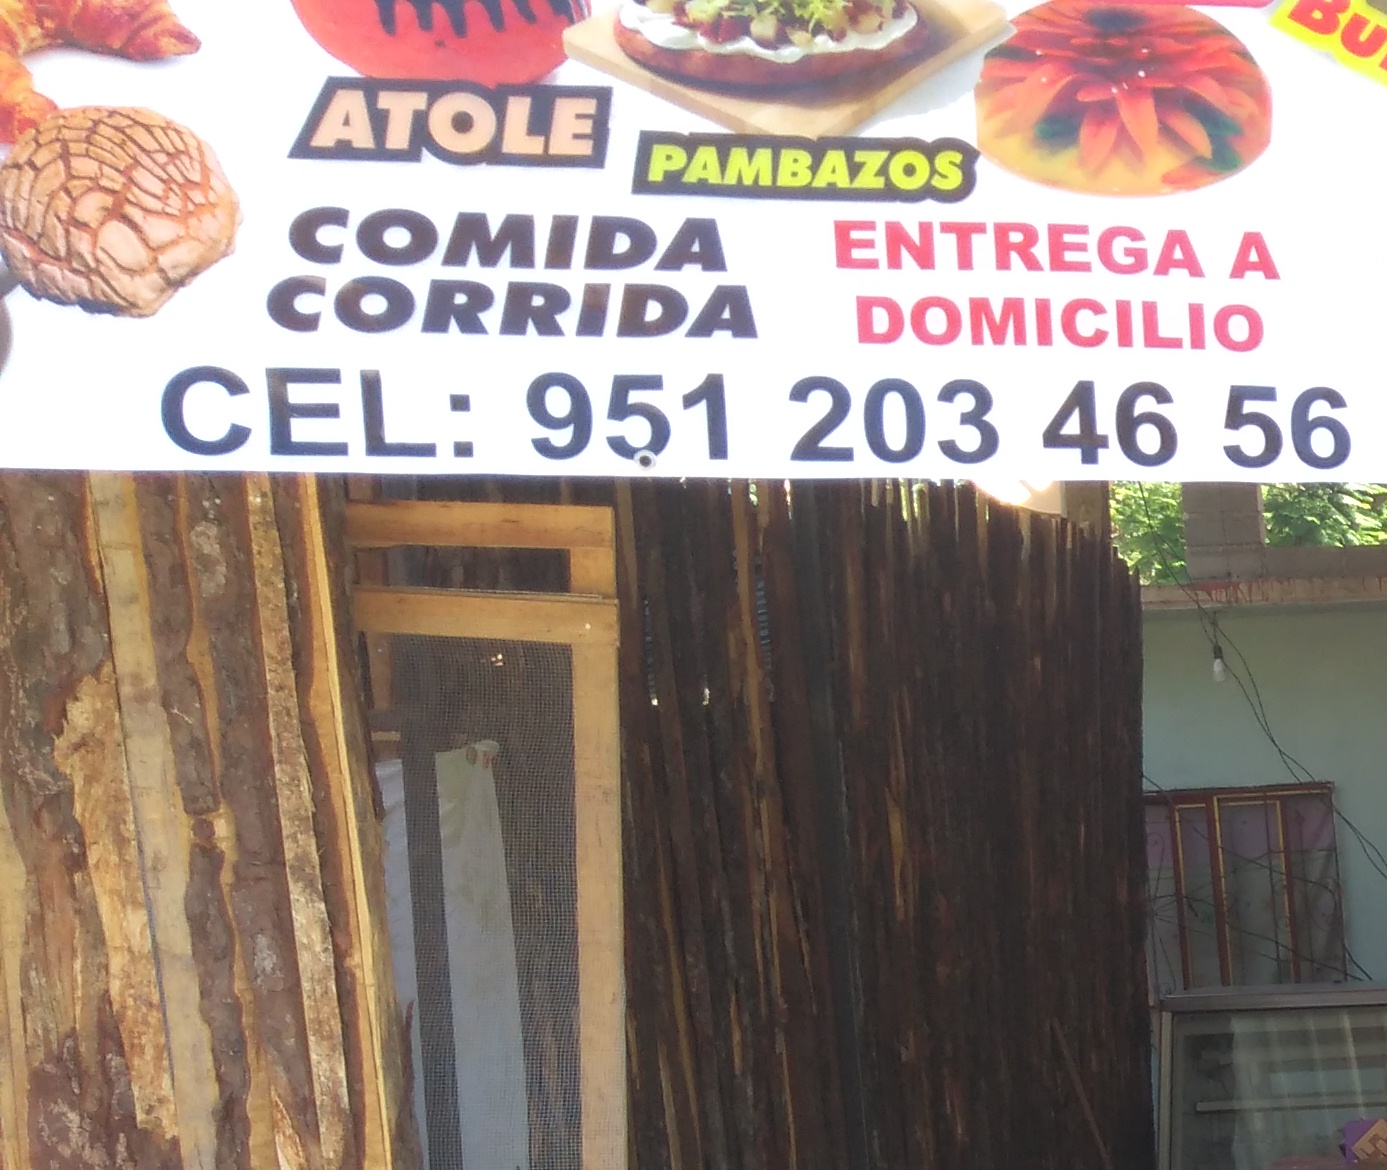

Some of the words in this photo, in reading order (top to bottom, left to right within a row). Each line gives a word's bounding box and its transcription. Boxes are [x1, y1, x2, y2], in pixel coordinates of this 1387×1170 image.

[309, 90, 600, 156] ATOLE
[648, 144, 963, 191] PAMBAZOS
[288, 207, 727, 272] COMIDA
[834, 220, 1204, 279] ENTREGA
[1230, 232, 1280, 281] A
[266, 275, 758, 339] CORRIDA
[856, 295, 1264, 352] DOMICILIO
[160, 366, 476, 458] CEL:
[526, 372, 729, 463] 951
[789, 376, 999, 464] 203
[1043, 380, 1178, 468] 46
[1223, 385, 1352, 470] 56
